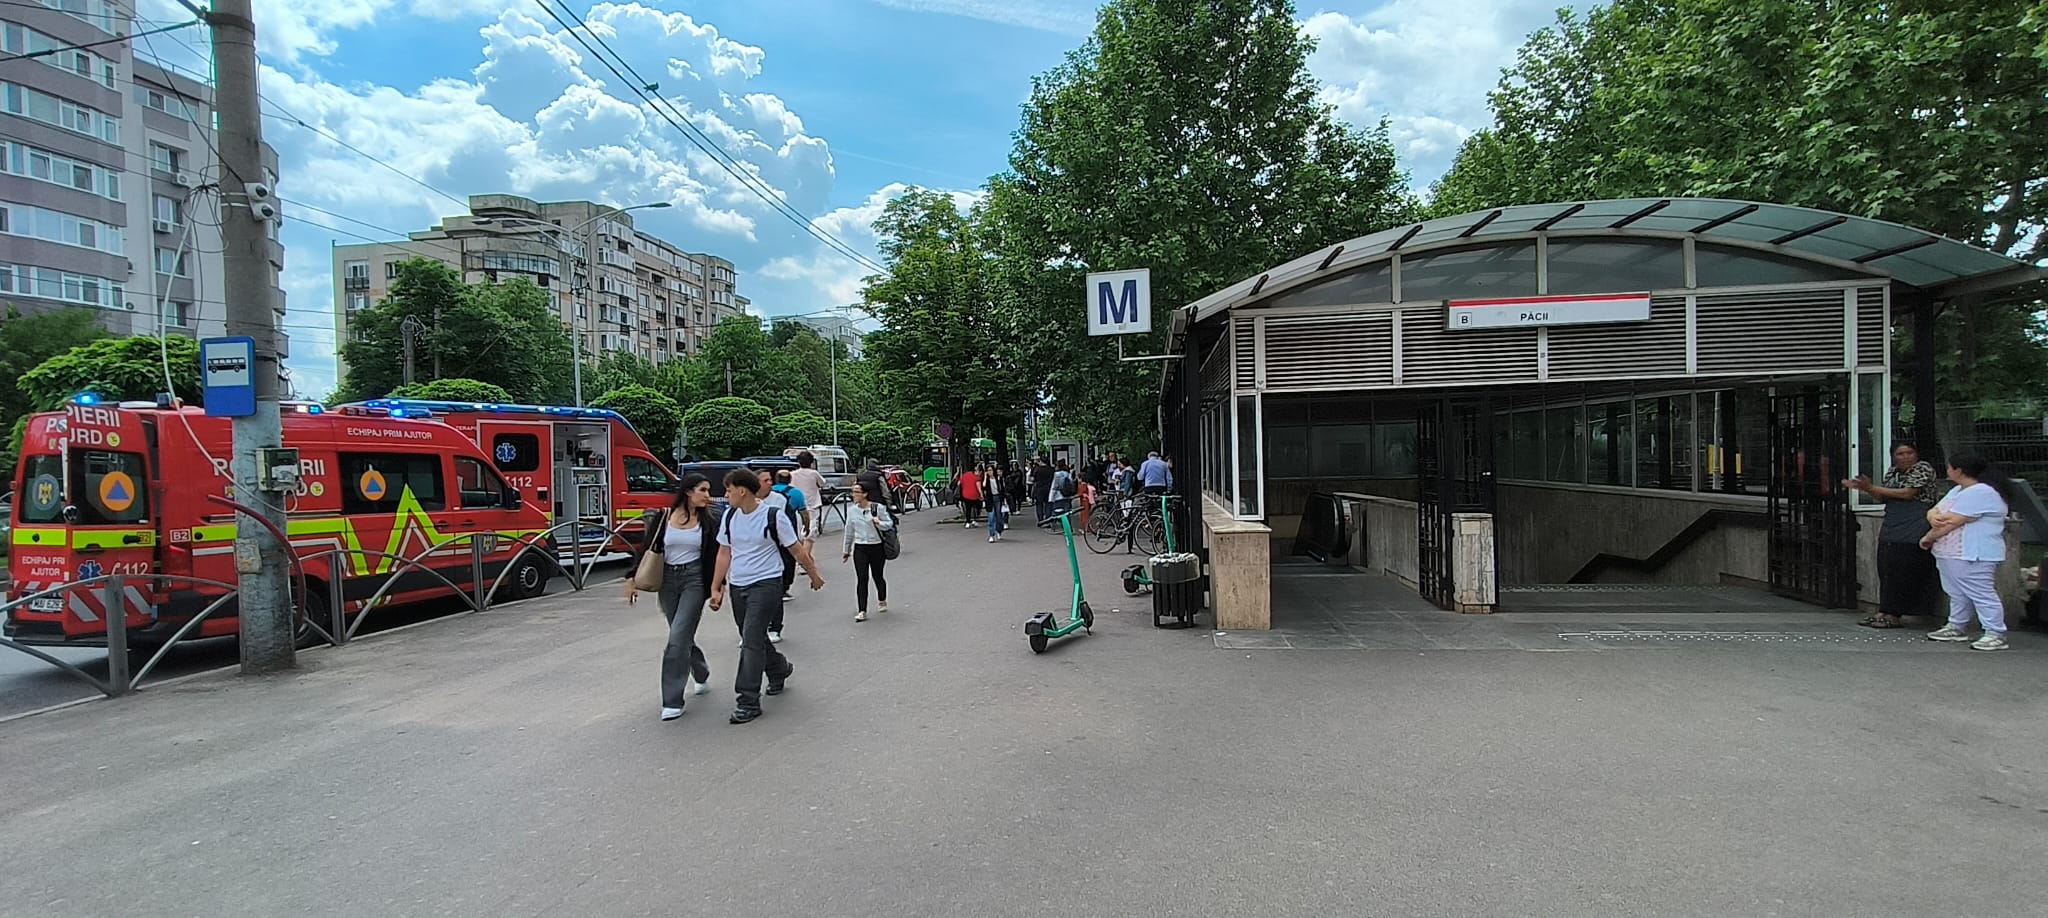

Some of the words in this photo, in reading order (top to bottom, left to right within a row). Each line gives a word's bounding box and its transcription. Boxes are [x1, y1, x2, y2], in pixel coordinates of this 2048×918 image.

[1098, 279, 1138, 325] M
[1461, 315, 1469, 324] B
[346, 427, 382, 437] ECHIPAJ
[383, 429, 403, 438] PRIM
[403, 430, 433, 440] AJUTOR
[511, 476, 533, 488] 112
[173, 531, 188, 541] B2
[22, 556, 51, 565] ECHIPAJ
[31, 567, 60, 576] AJUTOR
[123, 562, 148, 575] 112
